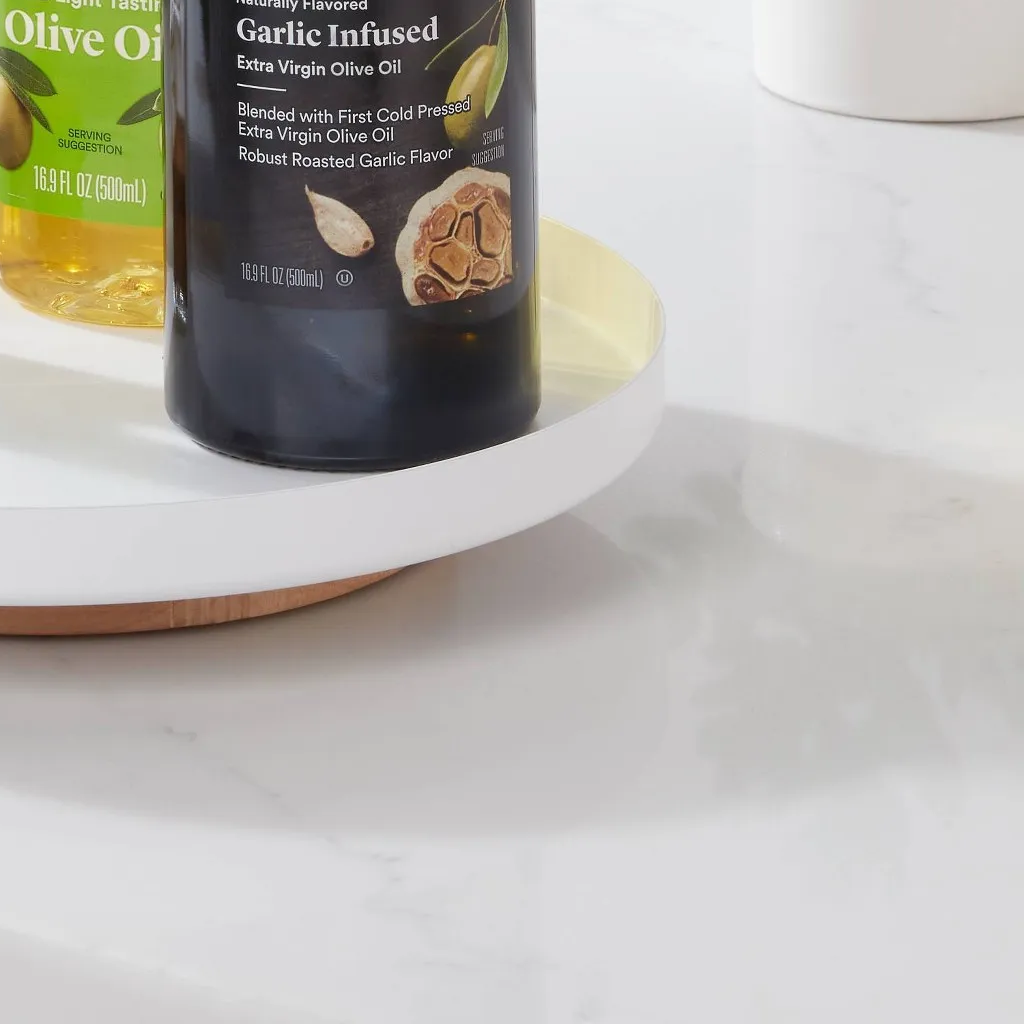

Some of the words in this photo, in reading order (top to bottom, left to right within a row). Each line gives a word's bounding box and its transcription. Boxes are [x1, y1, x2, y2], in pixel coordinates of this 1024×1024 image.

[4, 9, 105, 57] Olive
[114, 24, 162, 62] Oi
[236, 17, 321, 46] Garlic
[327, 15, 439, 47] Infused
[237, 55, 274, 74] Extra
[278, 59, 326, 79] Virgin
[330, 60, 374, 76] Olive
[378, 59, 402, 74] Oil
[238, 101, 295, 122] Blended
[299, 108, 334, 124] with
[338, 108, 373, 124] First
[376, 105, 413, 123] Cold
[418, 95, 471, 119] Pressed
[68, 128, 112, 142] SERVING
[238, 122, 273, 140] Extra
[277, 125, 322, 144] Virgin
[326, 127, 369, 143] Olive
[372, 126, 394, 142] Oil
[58, 139, 123, 156] SUGGESTION
[239, 146, 288, 167] Robust
[292, 152, 355, 168] Roasted
[359, 152, 406, 168] Garlic
[410, 146, 454, 164] Flavor
[33, 165, 57, 193] 16.9
[60, 171, 73, 196] FL
[77, 172, 93, 199] OZ
[95, 171, 147, 207] (500mL)
[240, 262, 258, 282] 16.9
[260, 264, 270, 284] FL
[272, 266, 284, 285] OZ
[286, 268, 324, 290] (500mL)
